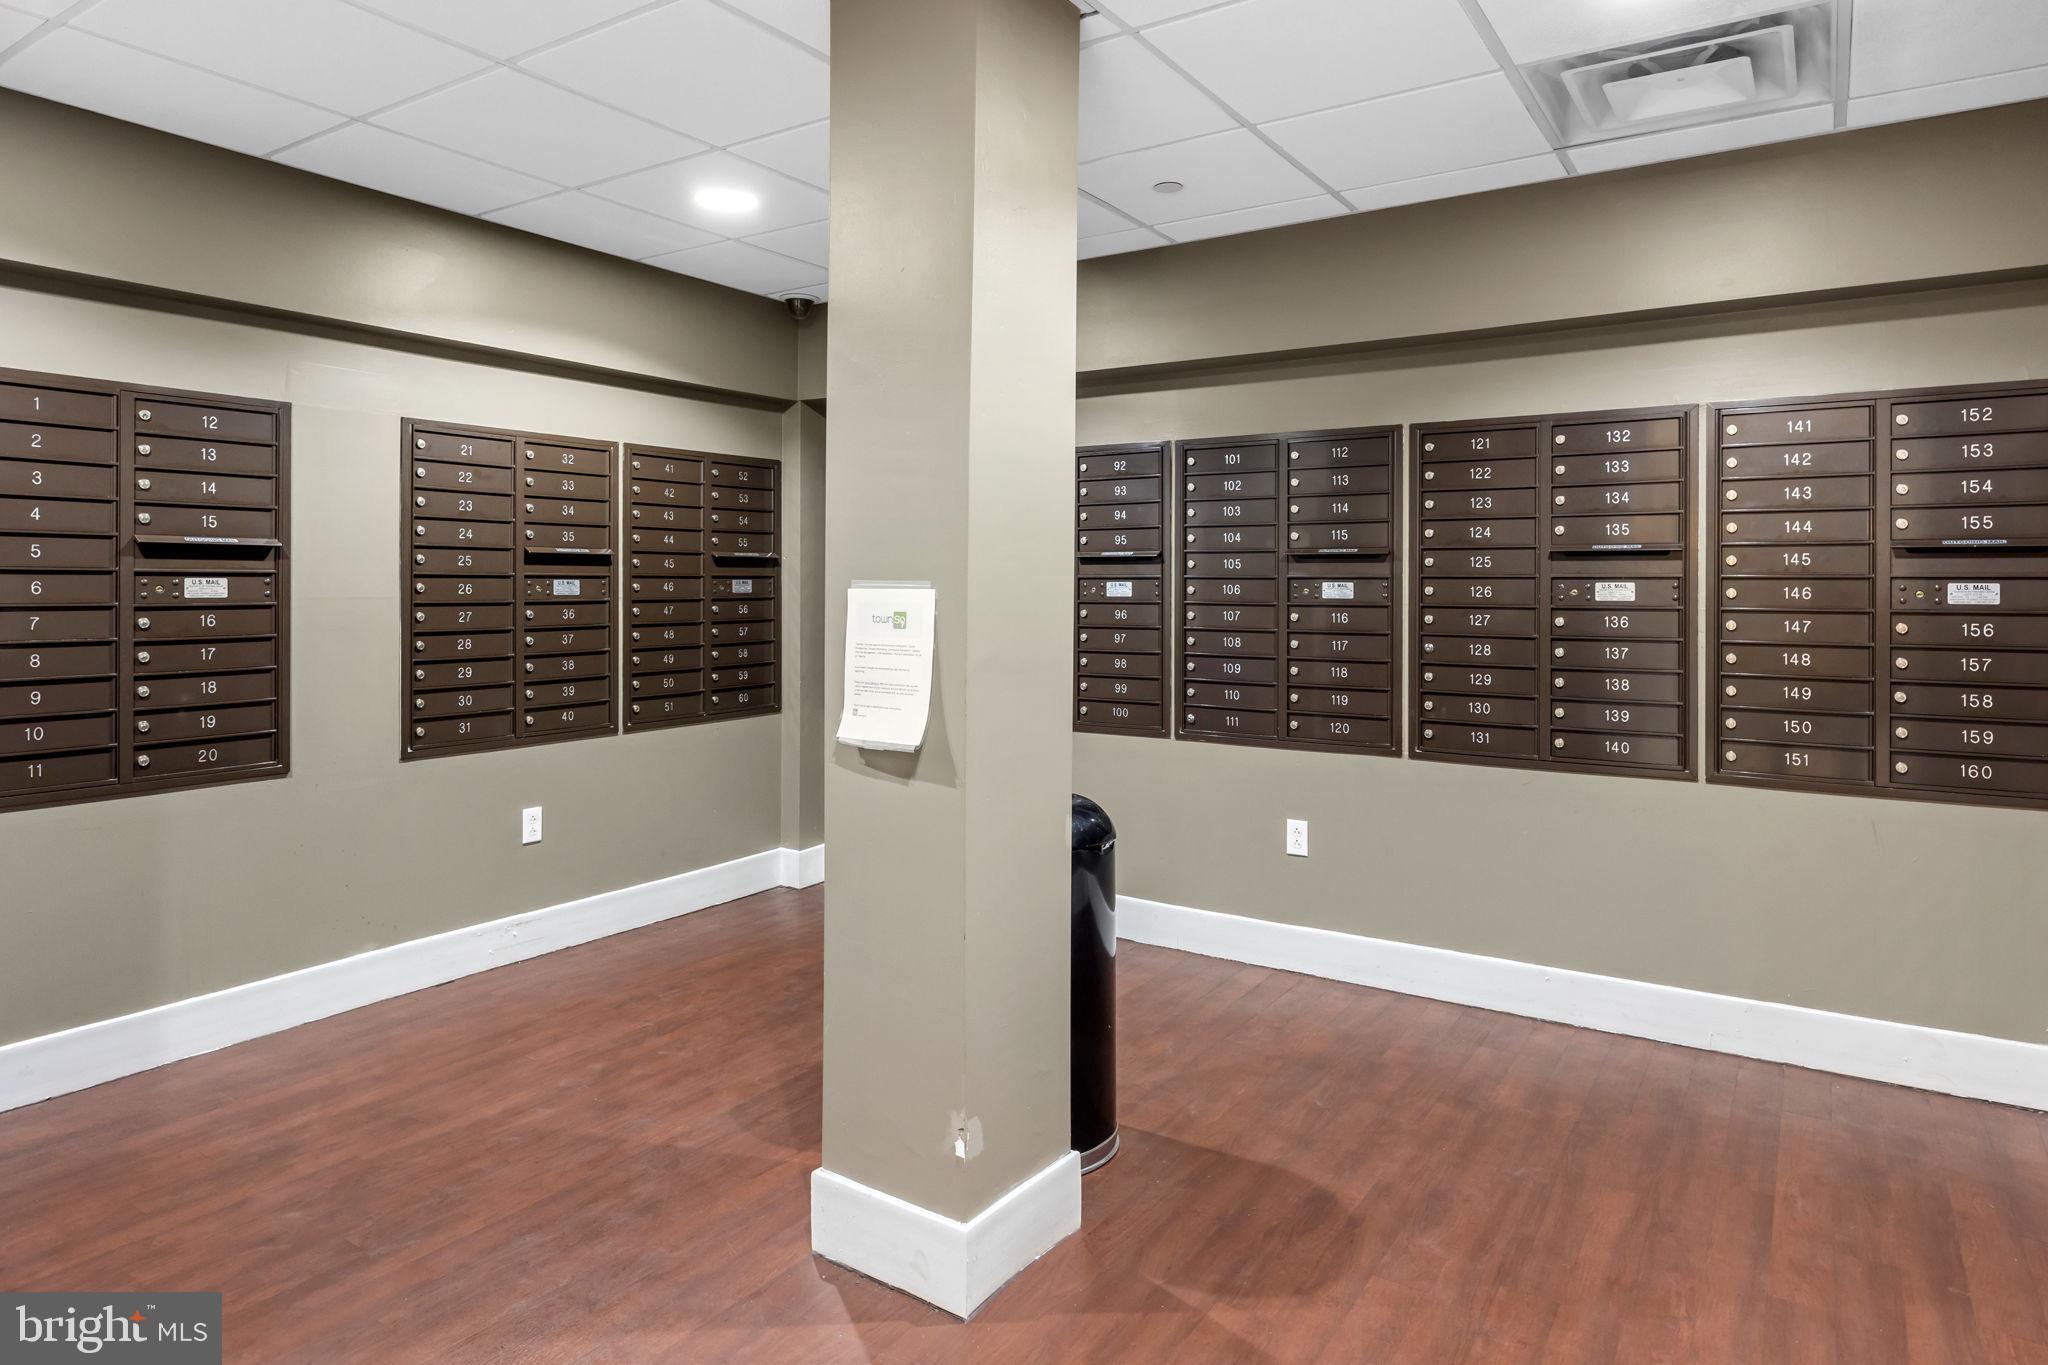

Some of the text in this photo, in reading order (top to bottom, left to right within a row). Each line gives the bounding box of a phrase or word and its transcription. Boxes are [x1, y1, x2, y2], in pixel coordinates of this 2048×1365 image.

[33, 396, 40, 411] 1
[1961, 407, 1993, 422] 152
[202, 415, 218, 430] 12
[1786, 419, 1811, 434] 141
[31, 433, 42, 448] 2
[1606, 429, 1631, 443] 132
[1471, 437, 1490, 450] 121
[200, 447, 217, 462] 13
[460, 444, 473, 456] 21
[1331, 446, 1349, 458] 112
[1961, 442, 1994, 458] 153
[561, 453, 575, 465] 32
[1224, 453, 1241, 465] 101
[1783, 452, 1812, 467] 142
[664, 463, 674, 473] 41
[1113, 460, 1126, 471] 92
[1605, 459, 1630, 473] 133
[31, 470, 42, 485] 3
[458, 471, 473, 483] 22
[738, 471, 748, 481] 52
[1469, 466, 1492, 479] 122
[562, 479, 575, 491] 33
[1223, 479, 1242, 491] 102
[1332, 474, 1349, 486] 113
[201, 481, 217, 495] 14
[664, 487, 675, 498] 42
[1114, 485, 1127, 496] 93
[1961, 479, 1993, 494] 154
[738, 493, 749, 504] 53
[1605, 491, 1630, 504] 134
[1784, 486, 1812, 500] 143
[458, 499, 473, 512] 23
[1332, 502, 1349, 513] 114
[1470, 496, 1492, 509] 123
[30, 507, 41, 521] 4
[562, 504, 574, 516] 34
[663, 510, 674, 521] 43
[1114, 510, 1127, 521] 94
[1223, 505, 1241, 517] 103
[201, 515, 218, 529] 15
[738, 516, 749, 526] 54
[1784, 520, 1813, 534] 144
[1961, 515, 1994, 530] 155
[458, 527, 473, 539] 24
[1331, 529, 1348, 541] 115
[1469, 526, 1492, 539] 124
[1605, 523, 1630, 536] 135
[562, 531, 575, 542] 35
[663, 535, 674, 544] 44
[738, 537, 748, 548] 55
[1114, 534, 1127, 545] 95
[1223, 532, 1241, 543] 104
[30, 543, 41, 558] 5
[457, 555, 472, 567] 25
[663, 558, 675, 569] 45
[1223, 558, 1242, 570] 105
[1470, 556, 1492, 568] 125
[1783, 552, 1811, 566] 145
[30, 580, 42, 595] 6
[458, 583, 473, 595] 26
[663, 581, 674, 592] 46
[1222, 584, 1241, 595] 106
[1470, 585, 1492, 598] 126
[1783, 586, 1812, 600] 146
[562, 608, 575, 620] 36
[663, 605, 674, 615] 47
[738, 604, 749, 614] 56
[1114, 609, 1128, 620] 96
[199, 614, 216, 627] 16
[458, 611, 473, 623] 27
[1223, 610, 1241, 621] 107
[1331, 612, 1349, 624] 116
[1469, 614, 1491, 626] 127
[29, 616, 40, 631] 7
[1604, 615, 1629, 629] 136
[1784, 620, 1812, 633] 147
[663, 629, 675, 640] 48
[738, 626, 748, 637] 57
[1961, 623, 1994, 638] 156
[457, 638, 472, 650] 28
[561, 633, 574, 645] 37
[1114, 633, 1127, 644] 97
[1223, 636, 1242, 648] 108
[1331, 640, 1349, 651] 117
[1469, 643, 1492, 656] 128
[200, 647, 216, 661] 17
[663, 654, 674, 664] 49
[738, 648, 749, 658] 58
[1605, 647, 1629, 660] 137
[29, 653, 41, 668] 8
[561, 659, 575, 671] 38
[1114, 658, 1127, 669] 98
[1782, 652, 1811, 667] 148
[1960, 657, 1992, 672] 157
[457, 666, 473, 679] 29
[1223, 663, 1241, 674] 109
[1330, 666, 1348, 678] 118
[738, 670, 749, 681] 59
[1469, 673, 1492, 686] 129
[200, 680, 217, 694] 18
[663, 678, 675, 688] 50
[1114, 683, 1128, 694] 99
[1605, 678, 1630, 691] 138
[562, 685, 575, 697] 39
[1224, 689, 1240, 701] 110
[1783, 686, 1812, 701] 149
[30, 690, 41, 706] 9
[458, 694, 473, 707] 30
[738, 692, 749, 703] 60
[1331, 694, 1349, 706] 119
[1960, 693, 1993, 709] 158
[664, 701, 674, 712] 51
[1112, 707, 1129, 718] 100
[1468, 702, 1491, 715] 130
[561, 710, 575, 721] 40
[1225, 716, 1239, 727] 111
[1604, 709, 1630, 723] 139
[199, 715, 216, 729] 19
[458, 722, 471, 734] 31
[1330, 722, 1350, 734] 120
[1783, 719, 1812, 734] 150
[24, 726, 44, 741] 10
[1470, 731, 1490, 744] 131
[1961, 729, 1994, 745] 159
[1605, 740, 1630, 754] 140
[198, 748, 218, 763] 20
[1784, 752, 1809, 767] 151
[27, 763, 42, 778] 11
[1960, 764, 1993, 780] 160
